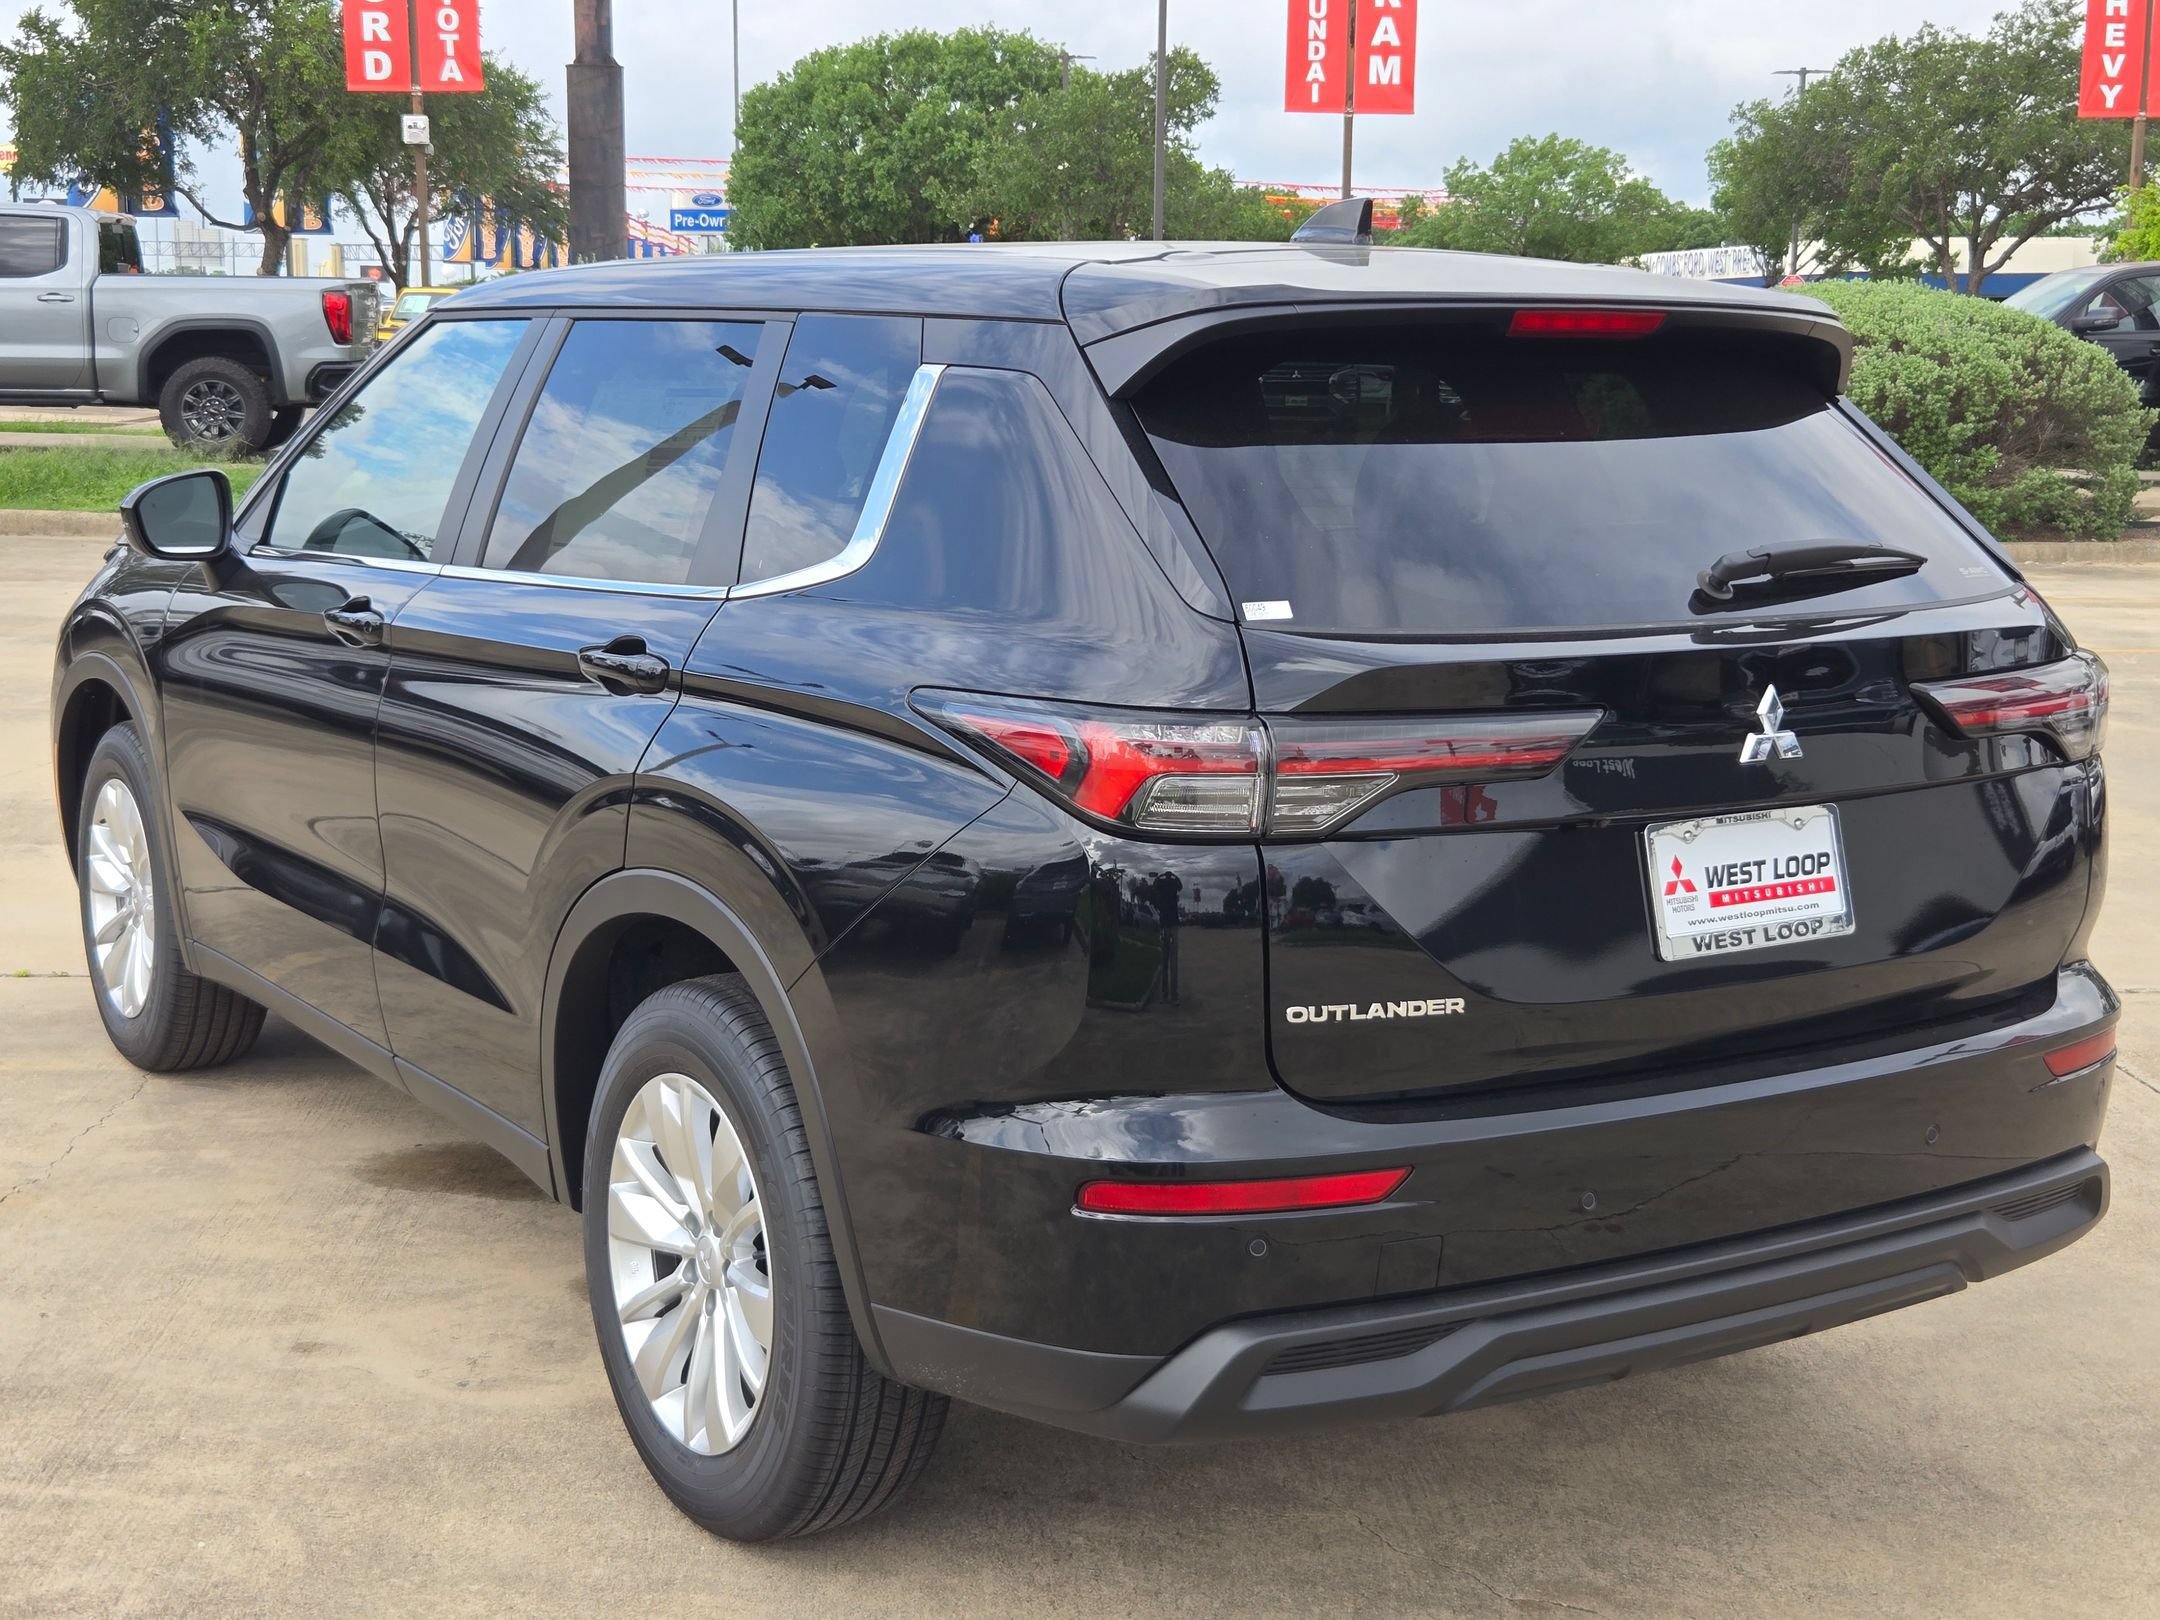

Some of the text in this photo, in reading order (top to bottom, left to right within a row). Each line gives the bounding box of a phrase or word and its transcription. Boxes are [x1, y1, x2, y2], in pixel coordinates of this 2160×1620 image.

[361, 0, 393, 81] RD
[1368, 0, 1402, 86] AM
[1715, 810, 1772, 825] MITSUBISHI
[1704, 851, 1831, 889] WEST LOOP
[1666, 895, 1699, 906] MITSUBISHI
[1721, 880, 1825, 903] MITSUBISHI
[1672, 904, 1696, 914] MOTORS
[1687, 901, 1820, 927] www.westloopmitsu.com
[1691, 917, 1824, 953] WEST LOOP
[1285, 997, 1466, 1024] OUTLANDER
